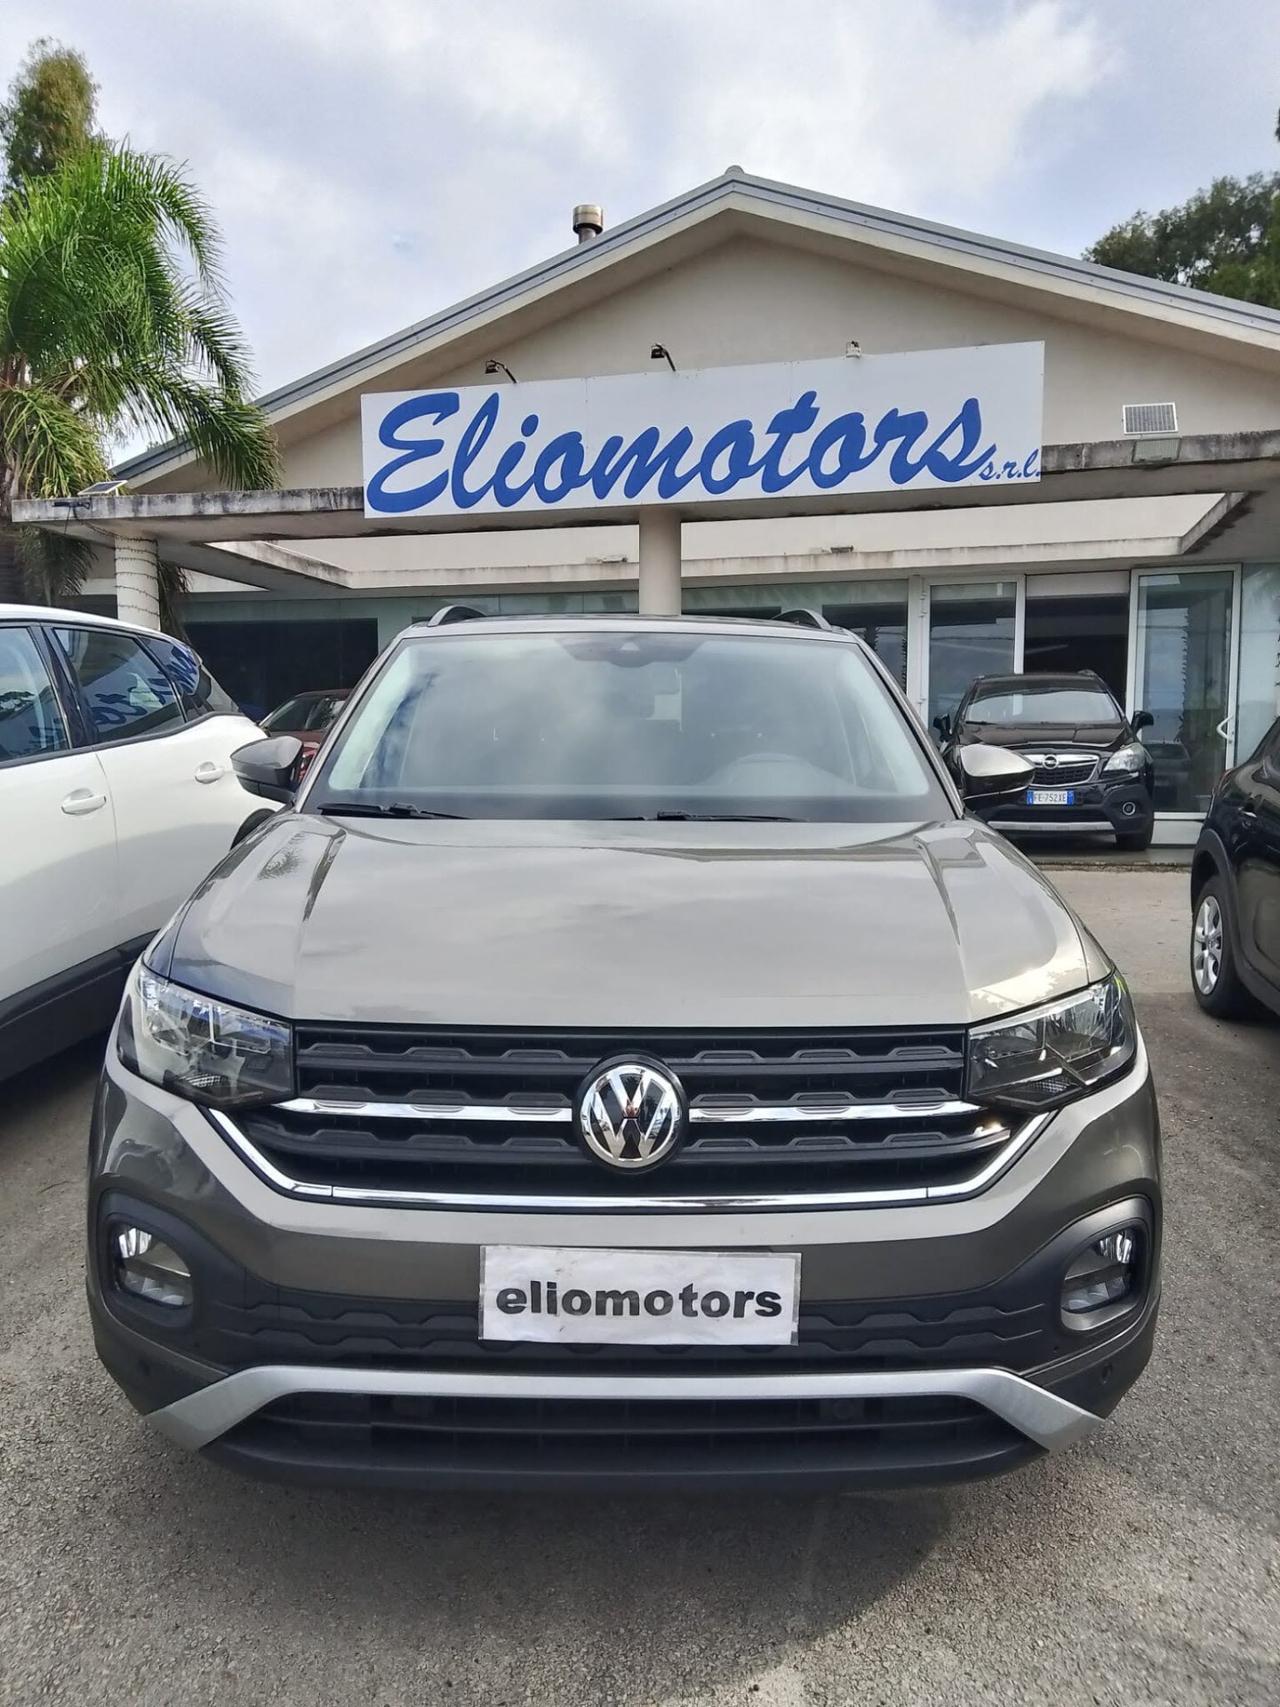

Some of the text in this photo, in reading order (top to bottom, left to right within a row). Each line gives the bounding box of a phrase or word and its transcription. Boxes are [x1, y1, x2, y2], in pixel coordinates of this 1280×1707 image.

[366, 390, 1040, 514] Eliomotors s.r.l.
[497, 1281, 781, 1318] eliomotors
